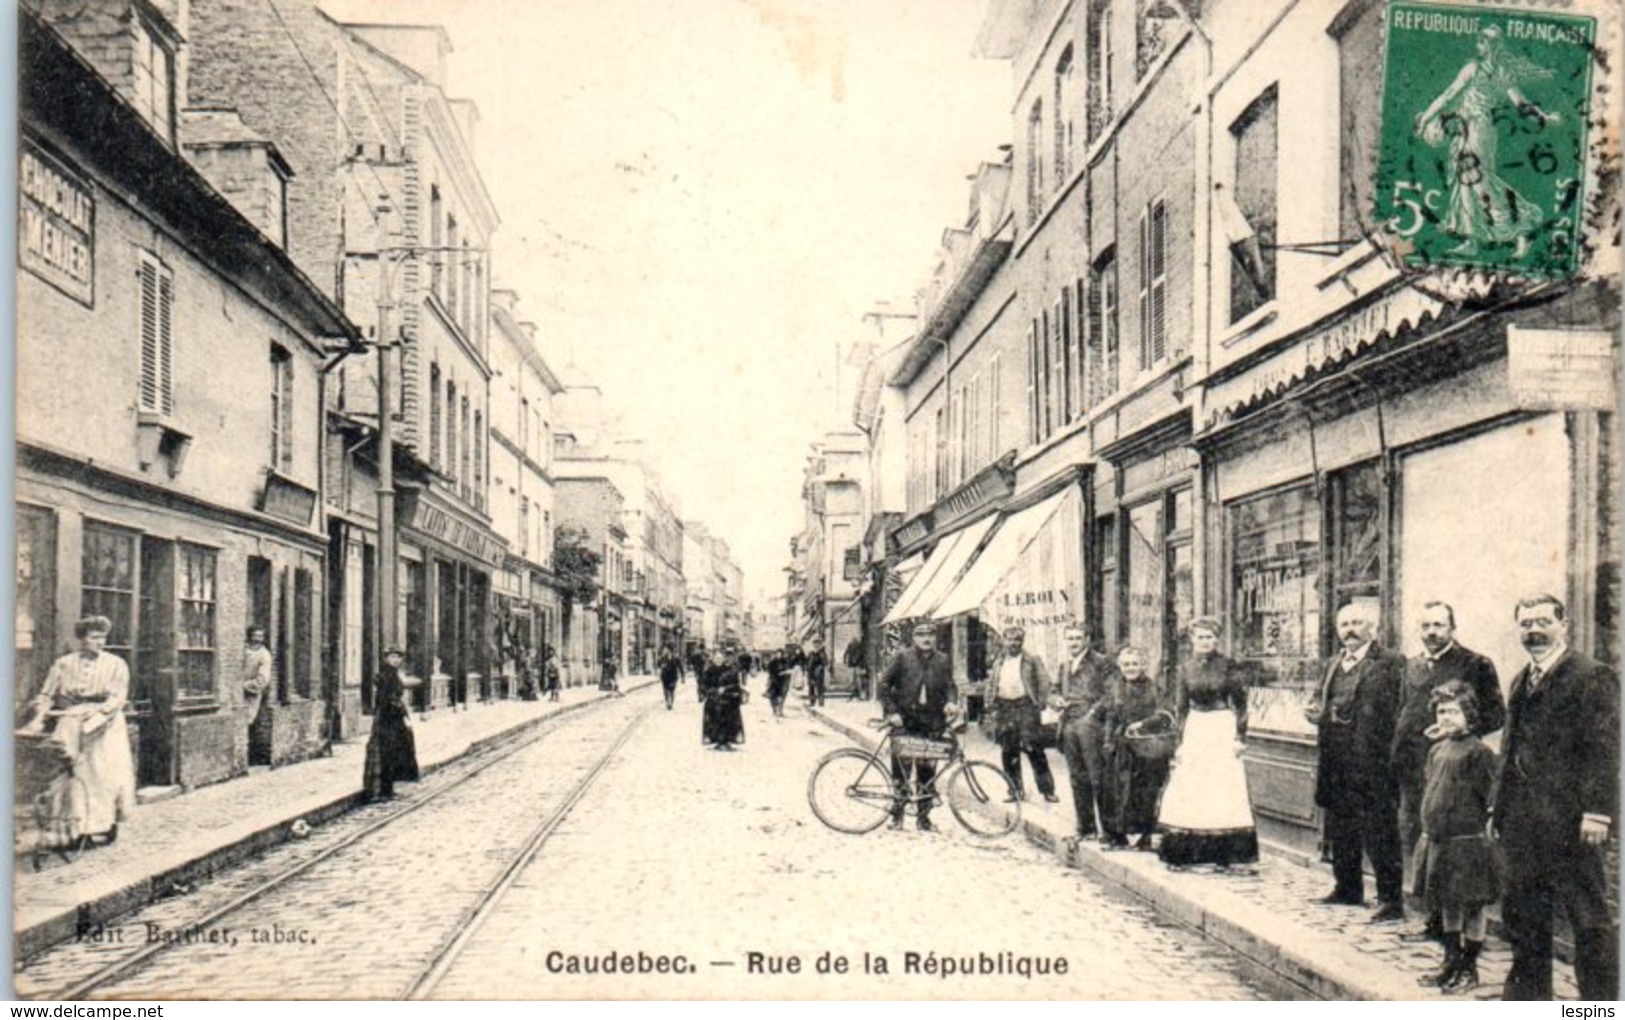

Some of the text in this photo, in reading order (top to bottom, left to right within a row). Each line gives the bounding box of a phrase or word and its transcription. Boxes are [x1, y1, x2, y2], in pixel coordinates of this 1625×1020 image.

[20, 153, 92, 237] CHOCOLAT
[25, 209, 89, 286] MENIER
[1003, 588, 1069, 607] LEROUX
